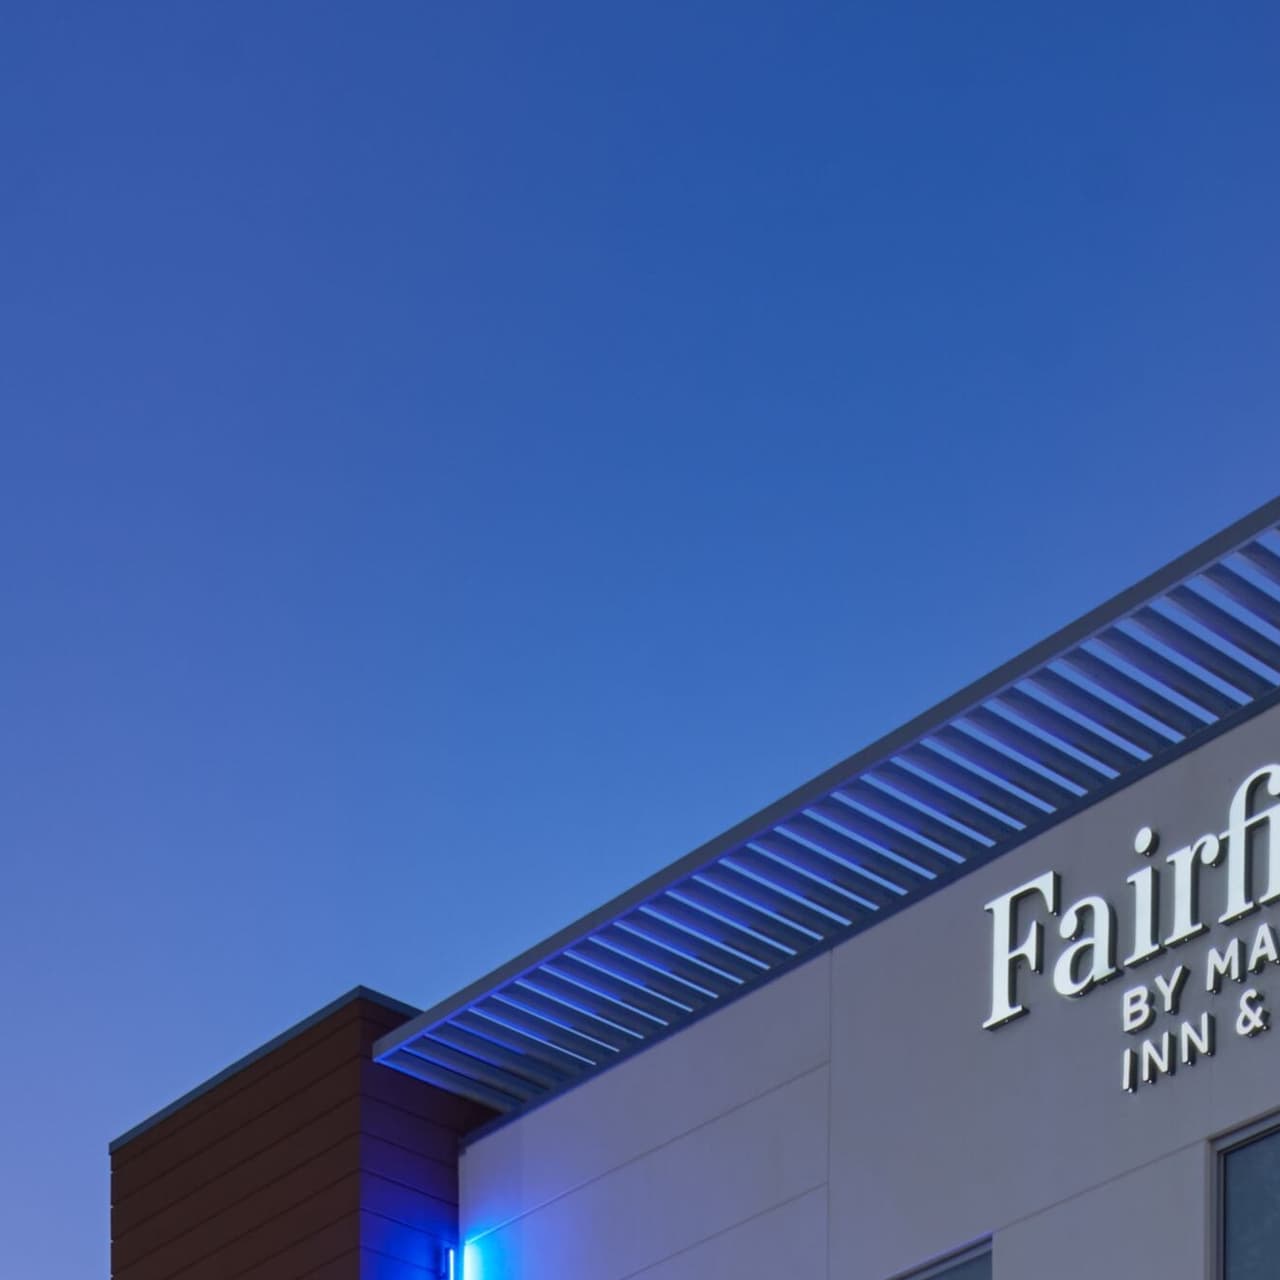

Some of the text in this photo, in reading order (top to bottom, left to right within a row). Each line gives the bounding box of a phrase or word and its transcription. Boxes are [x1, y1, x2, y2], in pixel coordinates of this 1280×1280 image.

[1122, 965, 1188, 1033] BY
[1122, 1011, 1215, 1092] INN
[1235, 988, 1269, 1037] &
